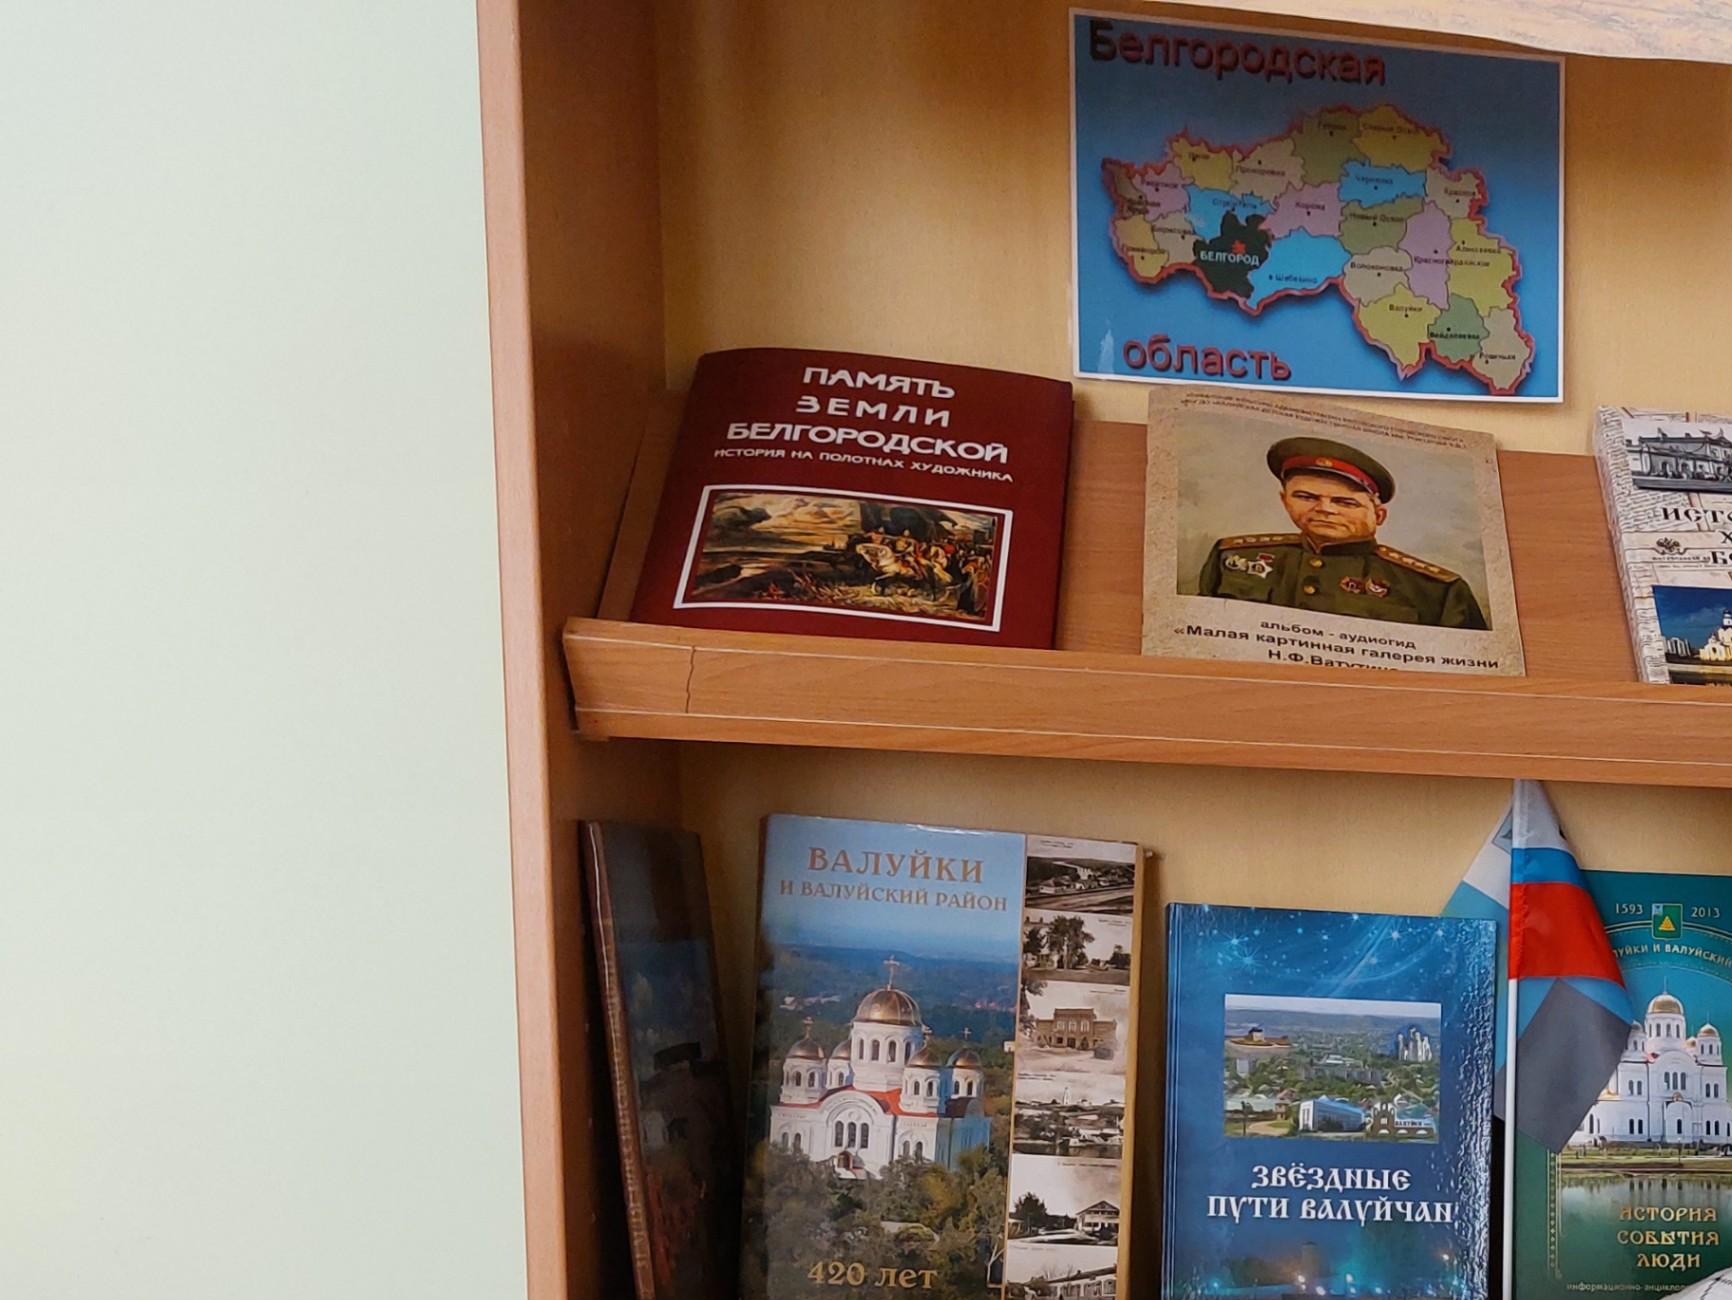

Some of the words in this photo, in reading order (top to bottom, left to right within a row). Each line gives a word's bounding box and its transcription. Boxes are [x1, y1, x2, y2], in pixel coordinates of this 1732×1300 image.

[1089, 19, 1385, 84] Белгородская
[1200, 251, 1259, 266] БЕЛГОРОД
[1123, 334, 1292, 380] область
[802, 366, 955, 399] ПАМЯТЬ
[796, 396, 951, 428] ЗЕМЛИ
[726, 422, 1009, 464] БЕЛГОРОДСКОЙ
[714, 447, 786, 460] ИСТОРИЯ
[792, 450, 813, 460] НА
[819, 451, 905, 469] ПОЛОТНАХ
[911, 461, 1014, 483] ХУДОЖНИКА
[1174, 624, 1249, 641] «Малая
[1256, 632, 1355, 657] картинная
[1360, 647, 1436, 666] галерея
[1441, 656, 1500, 670] жизни
[1260, 620, 1324, 638] альбом
[1339, 629, 1417, 649] аудиогид
[808, 846, 984, 884] ВАЛУЙКИ
[780, 880, 794, 894] И
[801, 880, 929, 905] ВАЛУЙСКИЙ
[935, 891, 1008, 911] РАЙОН
[1615, 902, 1644, 916] 1593
[1691, 905, 1721, 919] 2013
[1653, 943, 1660, 952] И
[1665, 943, 1732, 969] ВАЛУЙСКИЙ
[1251, 1161, 1411, 1192] ЗВЁЗДНЫЕ
[1207, 1195, 1289, 1227] ПУТИ
[1300, 1195, 1453, 1227] ВАЛУЙЧАН
[1619, 1206, 1718, 1223] ИСТОРИЯ
[1617, 1230, 1720, 1247] СОБЫТИЯ
[808, 1260, 866, 1286] 420
[875, 1266, 938, 1290] лет
[1637, 1253, 1701, 1270] ЛЮДИ
